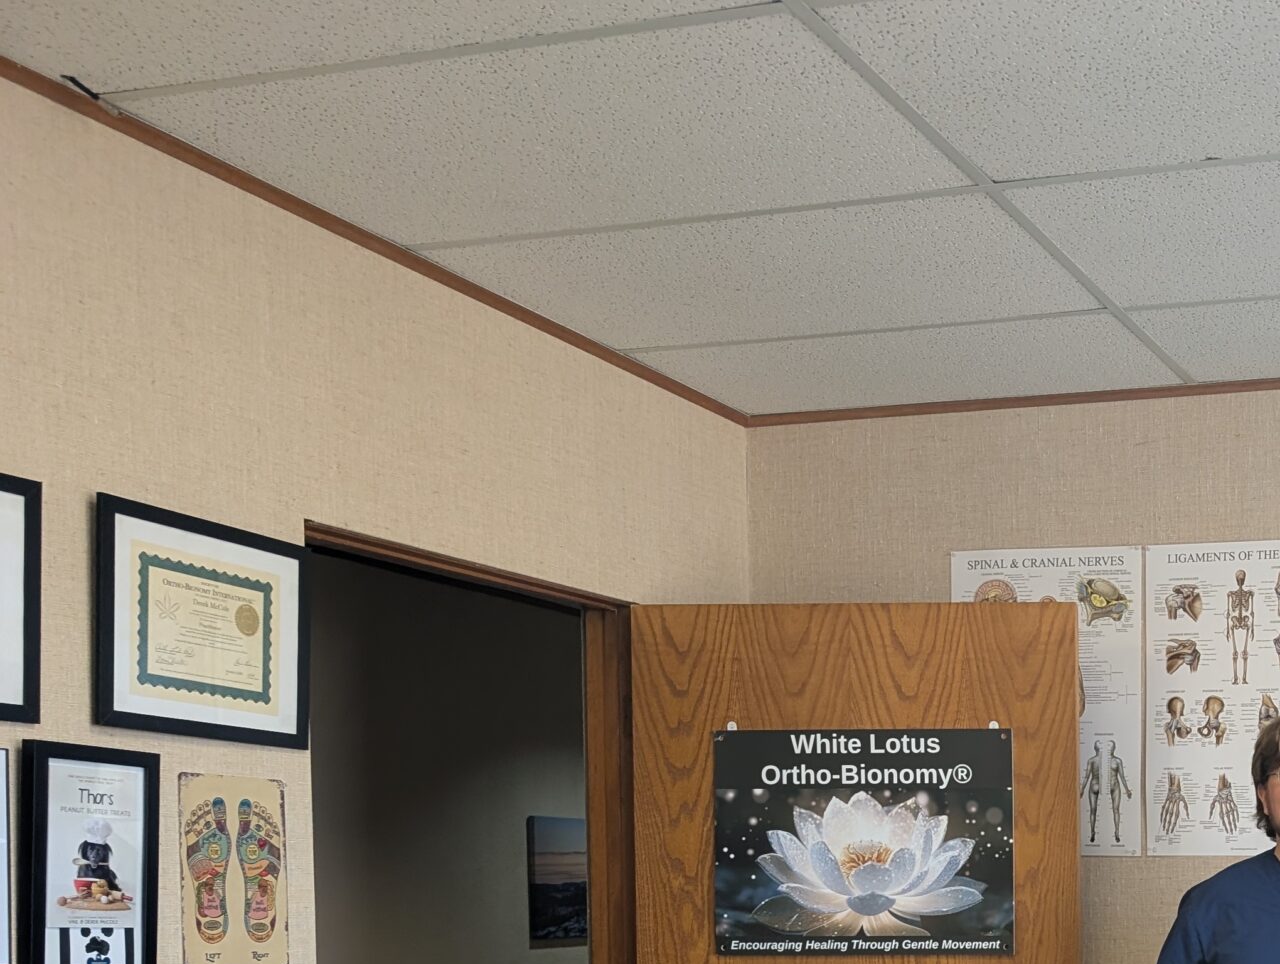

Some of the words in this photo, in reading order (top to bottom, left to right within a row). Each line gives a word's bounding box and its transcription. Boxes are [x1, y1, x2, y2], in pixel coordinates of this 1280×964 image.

[967, 559, 1006, 570] SPINAL
[1009, 558, 1020, 568] &
[1022, 557, 1075, 568] CRANIAL
[1078, 556, 1124, 567] NERVES
[1167, 551, 1235, 563] LIGAMENTS
[1238, 551, 1253, 561] OF
[1254, 550, 1280, 560] THE
[790, 733, 862, 754] White
[869, 733, 941, 754] Lotus
[761, 763, 973, 789] Ortho-Bionomy®
[730, 940, 803, 952] Encouraging
[805, 940, 849, 951] Healing
[851, 940, 899, 951] Through
[901, 939, 939, 950] Gentle
[941, 939, 1000, 950] Movement
